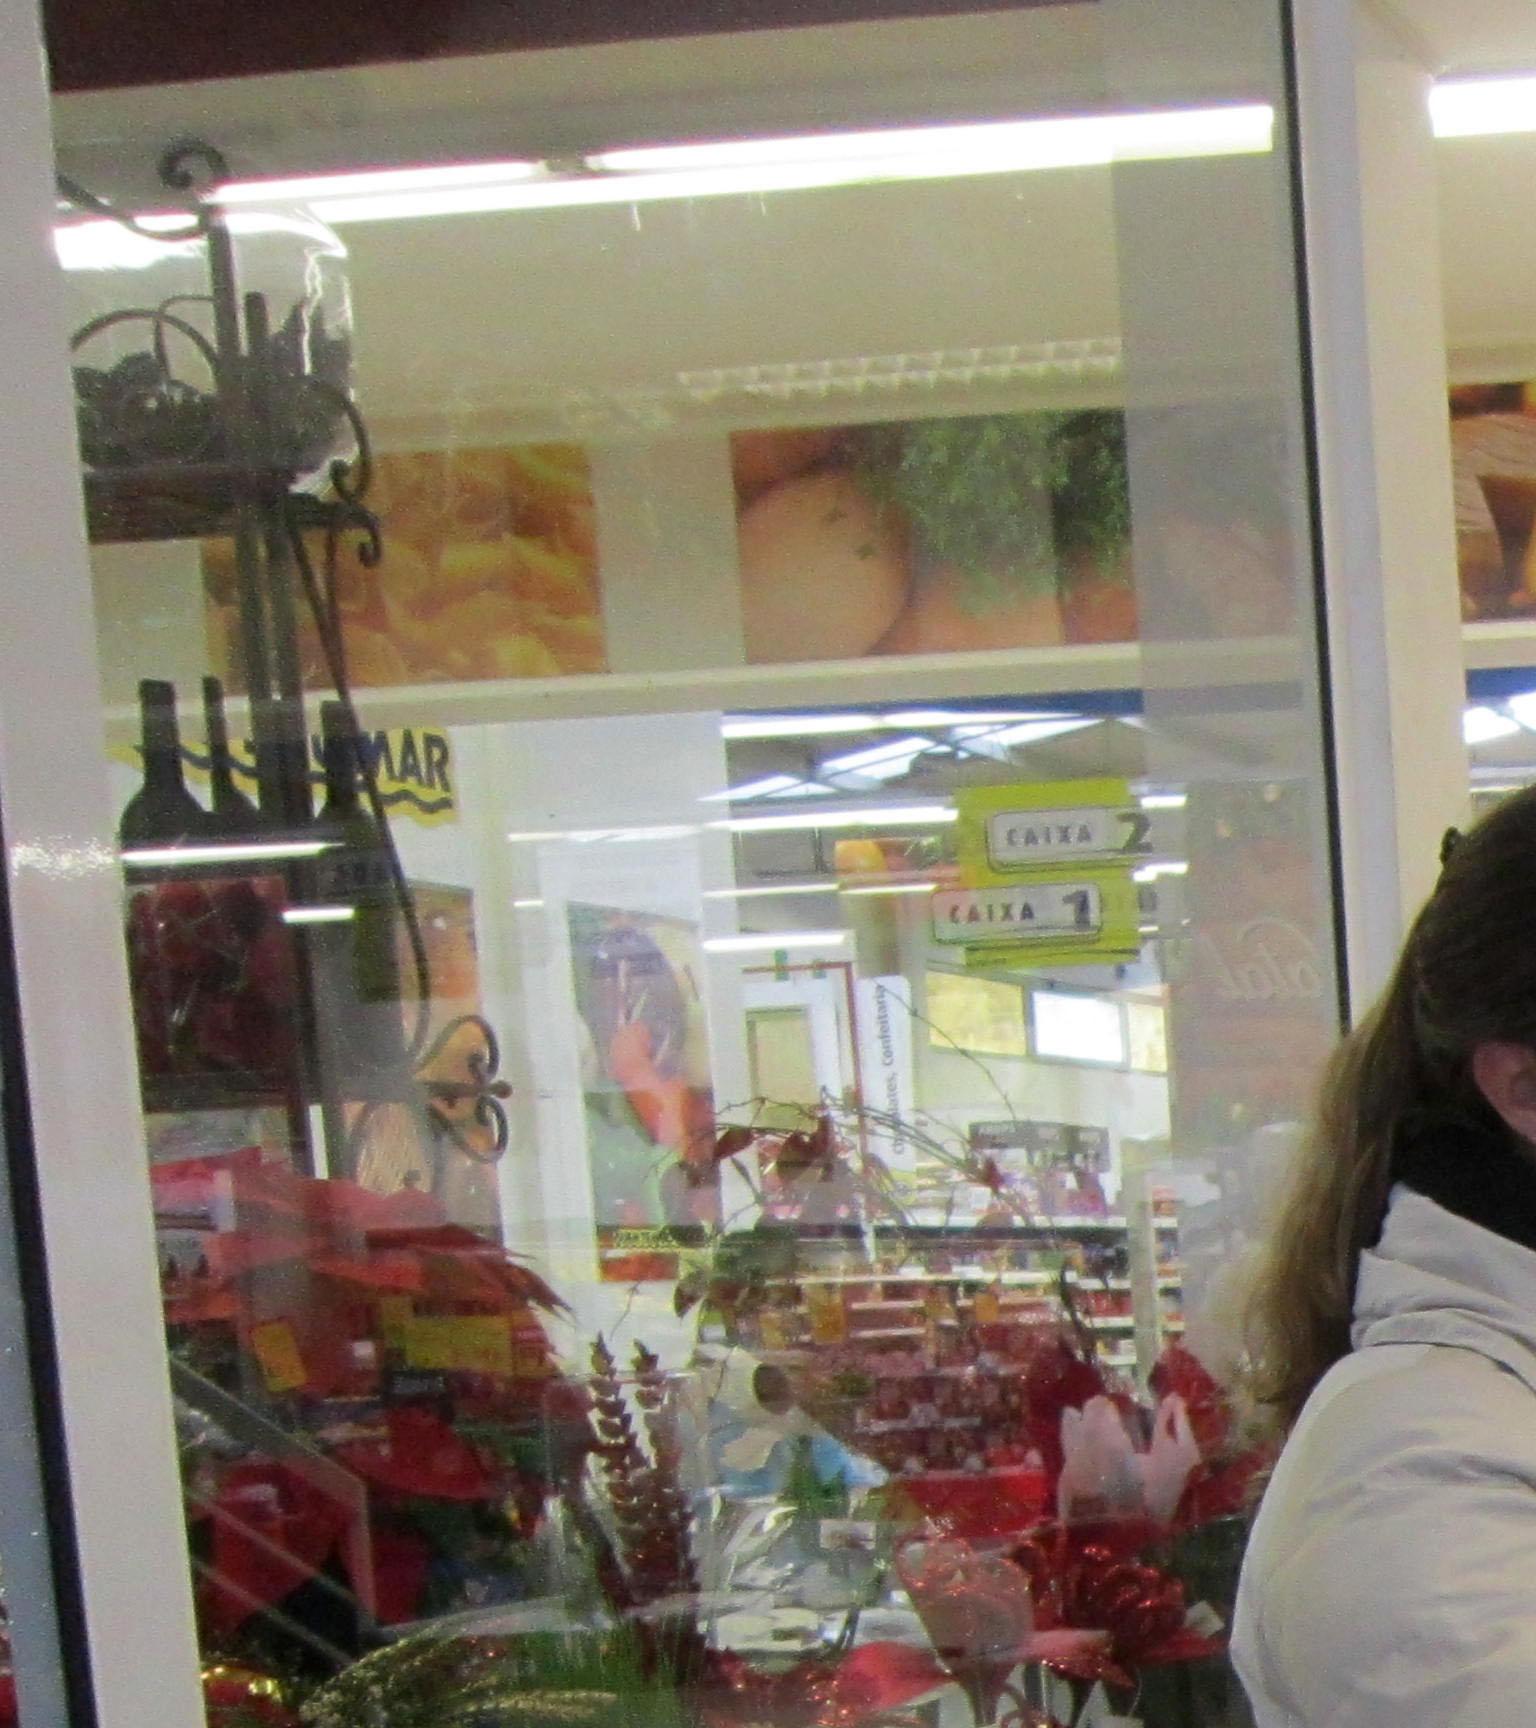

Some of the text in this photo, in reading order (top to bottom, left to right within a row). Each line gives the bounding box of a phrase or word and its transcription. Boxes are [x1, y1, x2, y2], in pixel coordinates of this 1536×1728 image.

[1006, 812, 1153, 854] CAIXA 2
[950, 889, 1091, 932] CAIXA 1
